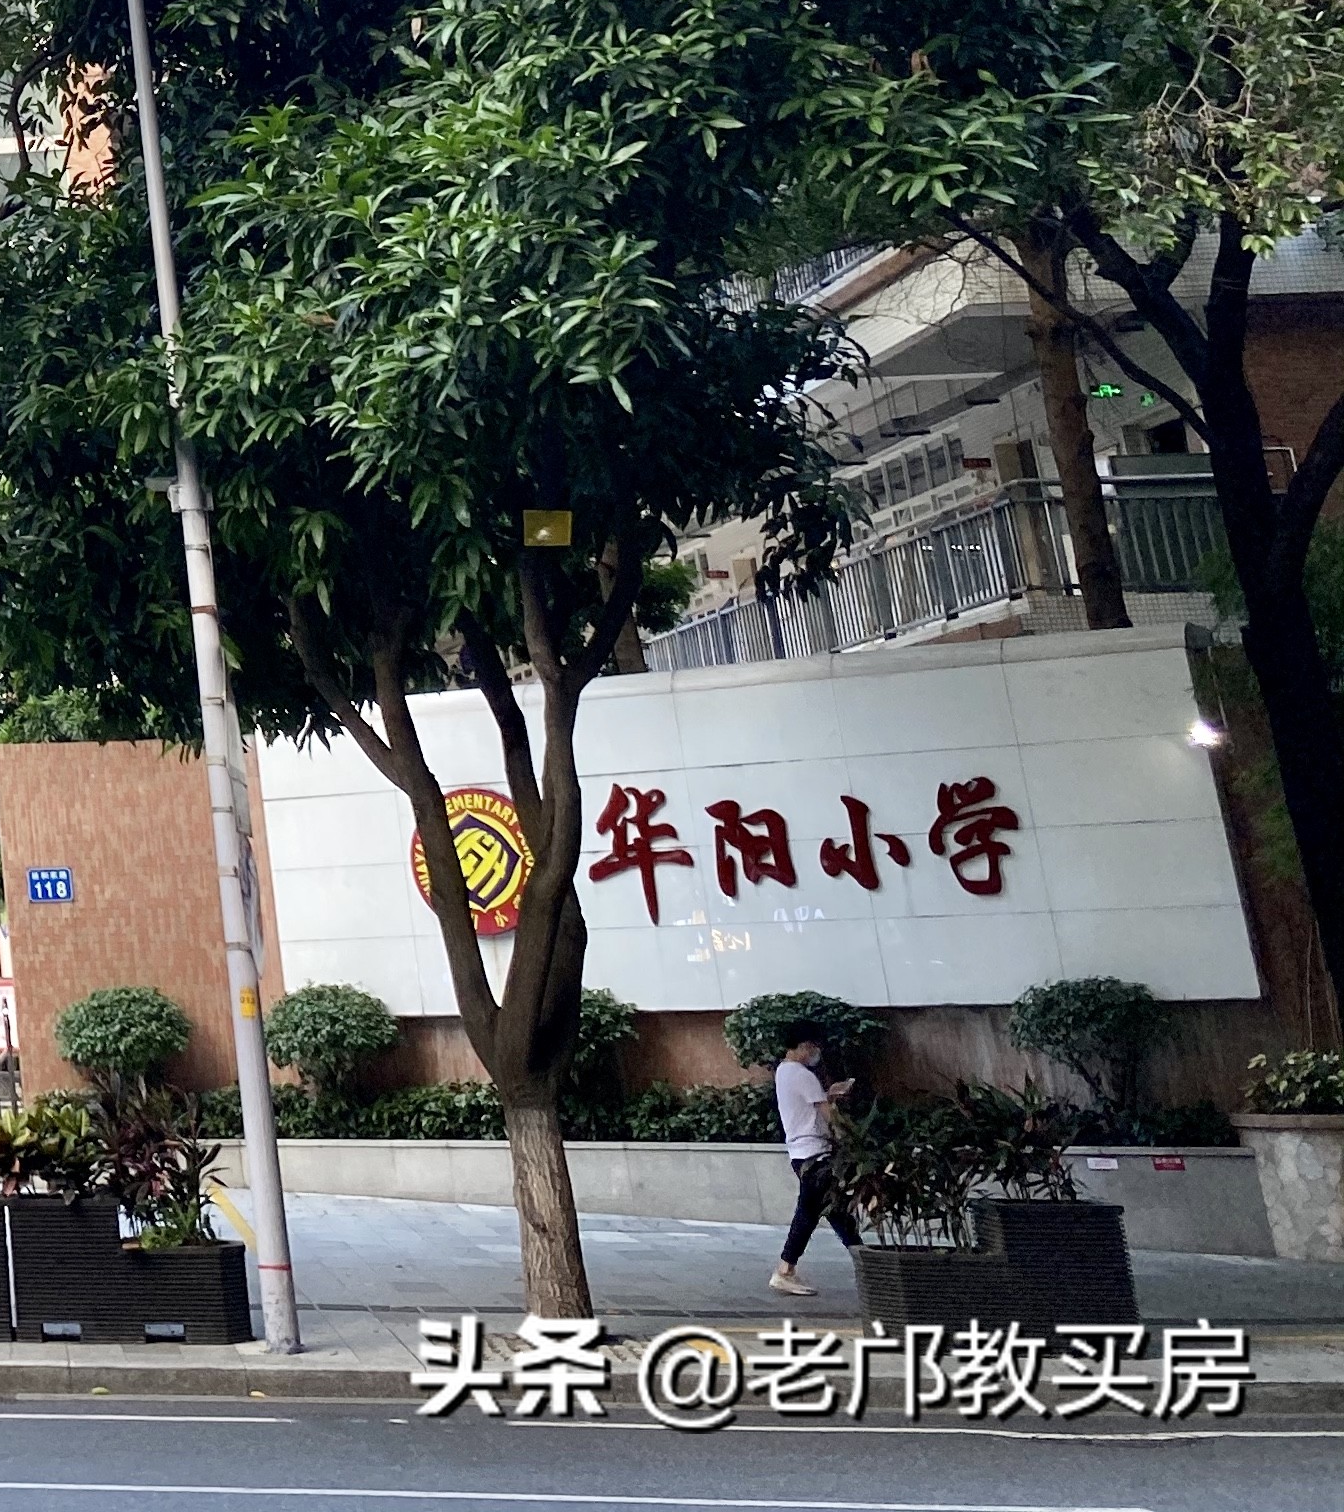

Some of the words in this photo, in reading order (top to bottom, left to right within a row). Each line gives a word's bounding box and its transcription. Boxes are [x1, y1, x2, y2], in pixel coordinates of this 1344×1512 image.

[34, 880, 68, 899] 118
[588, 777, 1019, 926] 华阳小学
